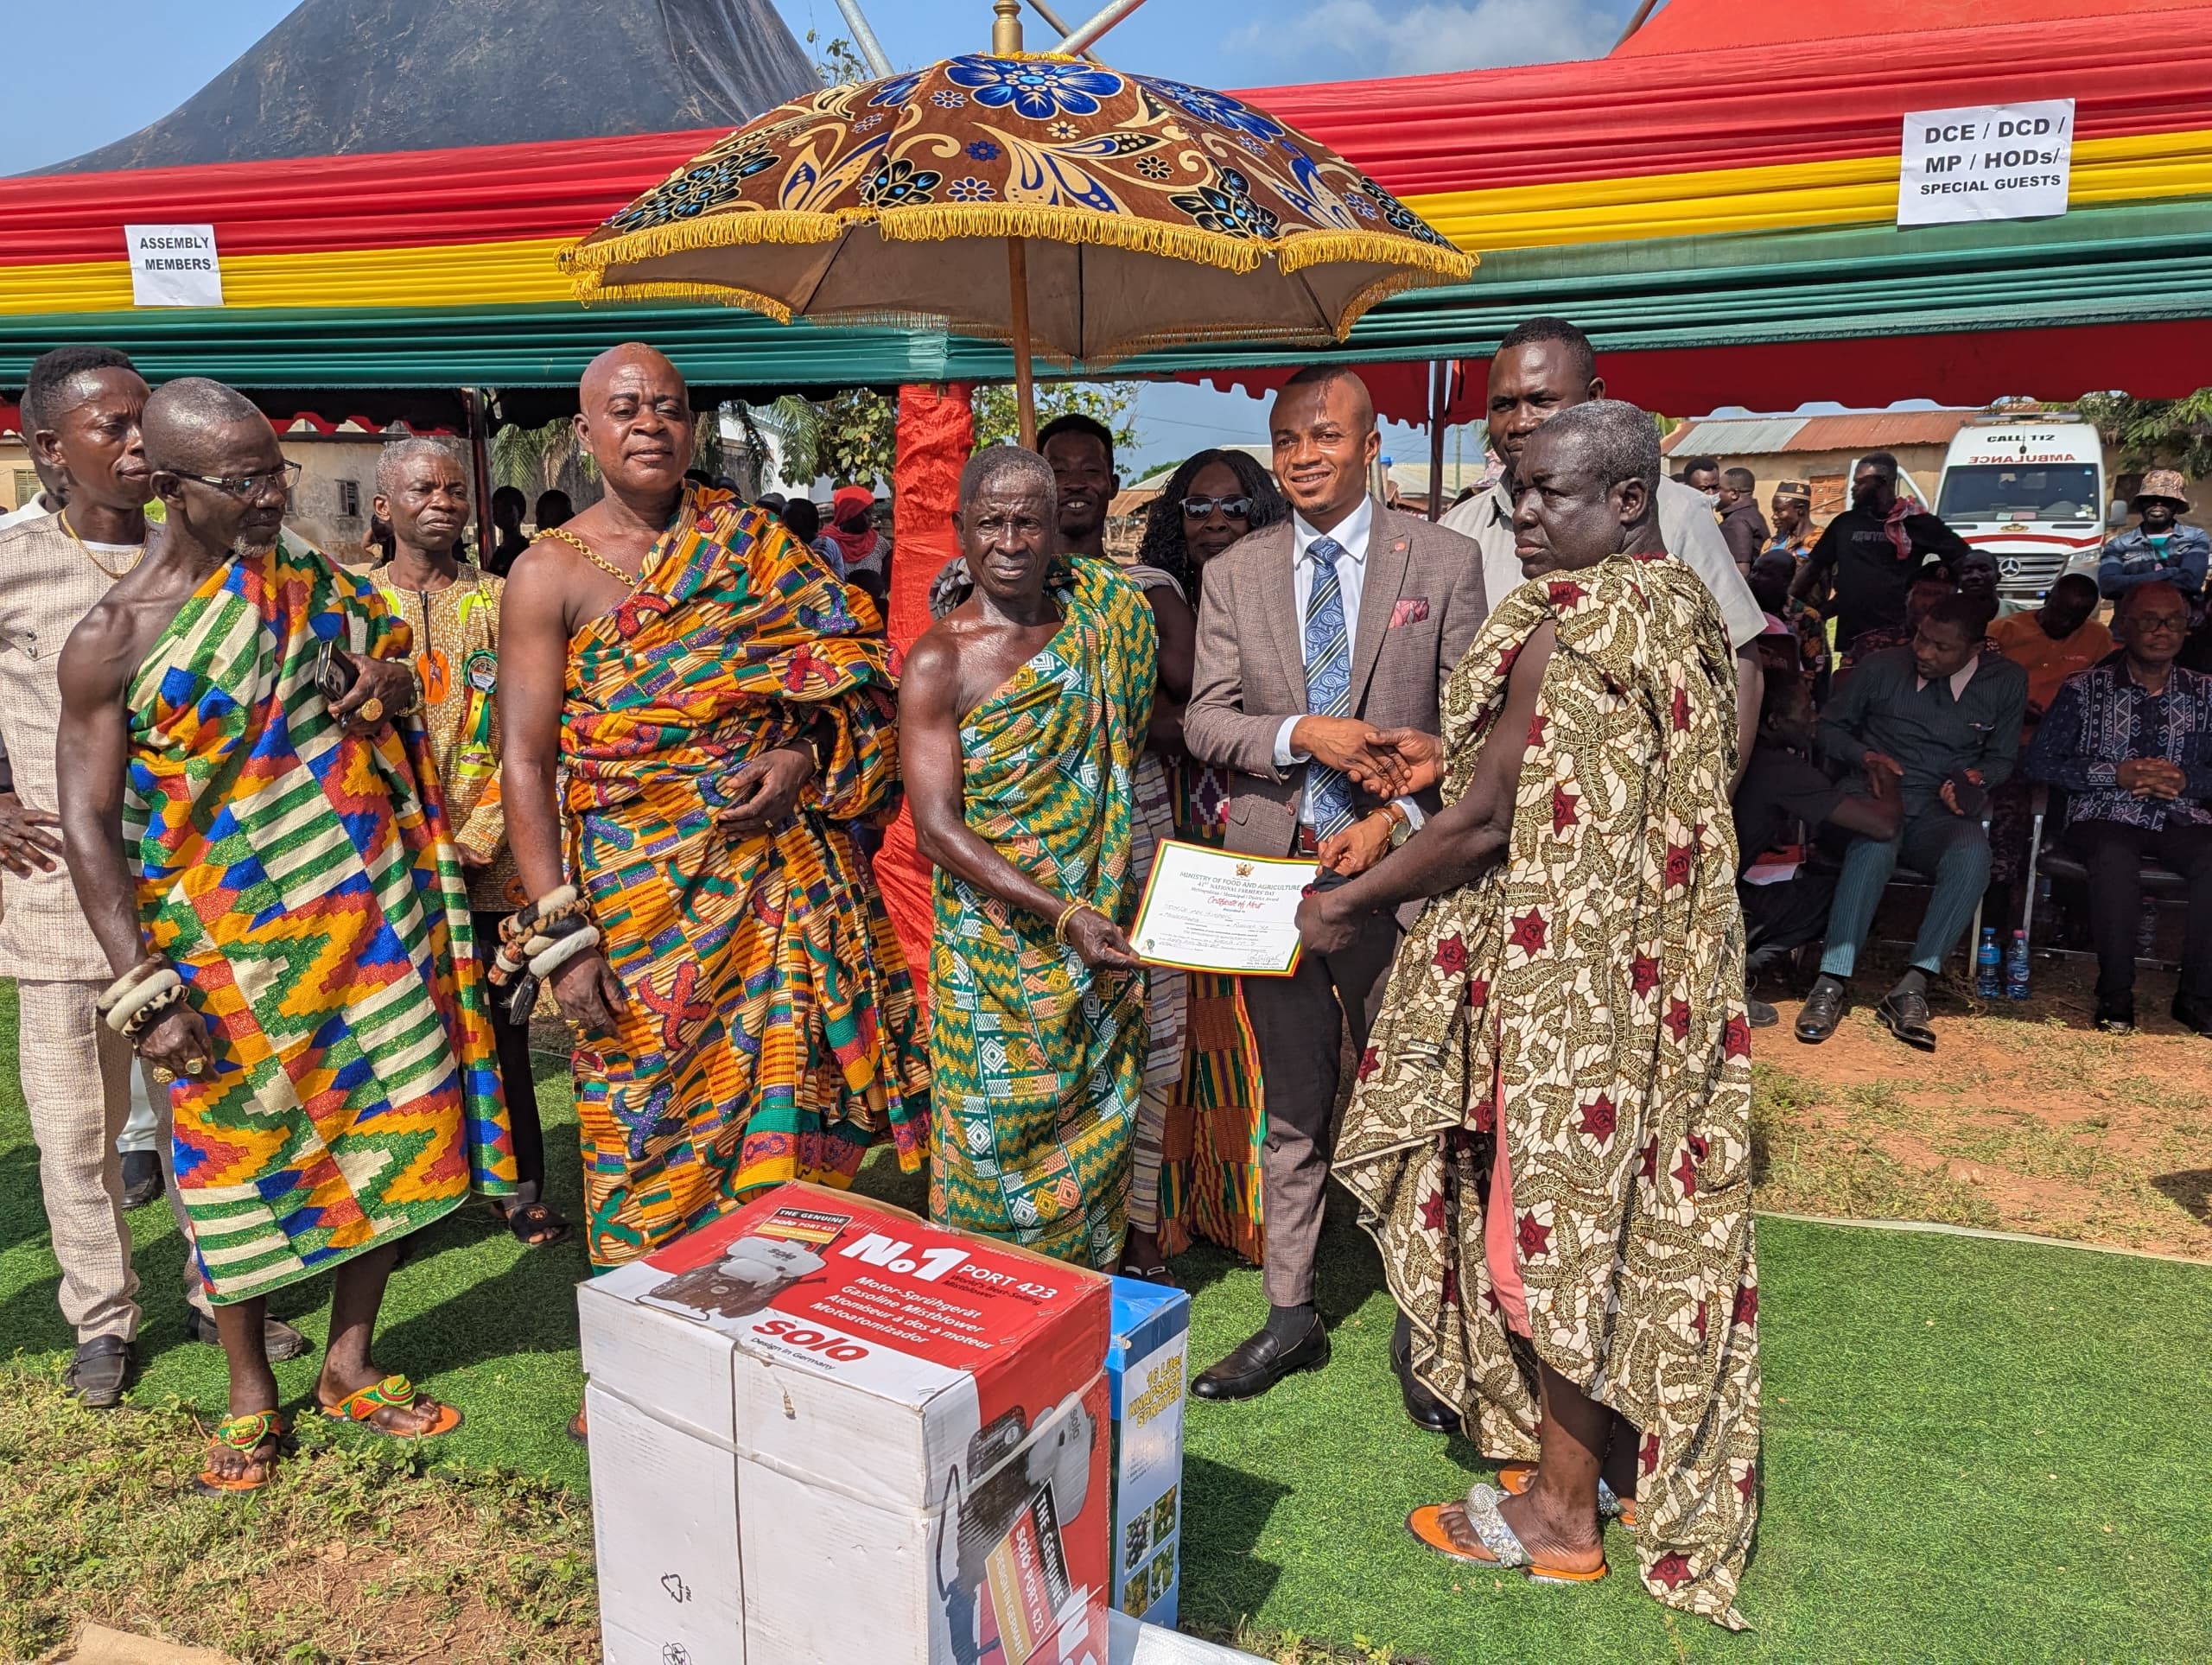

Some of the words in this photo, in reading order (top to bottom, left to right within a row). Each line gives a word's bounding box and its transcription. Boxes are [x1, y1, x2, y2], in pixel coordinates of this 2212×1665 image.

[1925, 124, 1975, 144] DCE
[1998, 118, 2050, 138] DCD
[1925, 155, 1962, 174] MP
[1984, 148, 2062, 169] HODs/
[1920, 181, 1989, 195] SPECIAL
[1994, 175, 2061, 191] GUESTS
[140, 237, 209, 250] ASSEMBLY
[145, 258, 212, 270] MEMBERS
[1986, 435, 2024, 443] CALL
[1179, 871, 1211, 885] MINISTRY
[1222, 878, 1242, 887] FOOD
[1242, 880, 1257, 889] AND
[1257, 882, 1301, 892] AGRICULTURE
[1209, 883, 1237, 893] NATIONAL
[800, 1212, 846, 1224] GENUINE
[854, 1275, 983, 1319] Motor-Sprühgerät
[957, 1263, 1018, 1287] PORT
[1016, 1281, 1058, 1300] 423
[809, 1301, 931, 1344] Motoatomizador
[825, 1293, 895, 1319] Atomiseur
[893, 1313, 906, 1324] à
[903, 1318, 931, 1331] dos
[930, 1325, 943, 1335] à
[941, 1330, 995, 1350] moteur
[841, 1284, 901, 1308] Gasoline
[900, 1304, 985, 1333] Mistblower
[751, 1337, 783, 1351] Design
[792, 1351, 836, 1370] Germany
[1147, 1366, 1160, 1389] 16
[1160, 1351, 1183, 1378] Liter
[1128, 1368, 1183, 1420] KNAPSACK
[1136, 1382, 1182, 1429] SPRAYER
[1035, 1492, 1051, 1533] THE
[1042, 1531, 1065, 1608] GENUINE
[1024, 1568, 1039, 1611] PORT
[1031, 1607, 1045, 1635] 423
